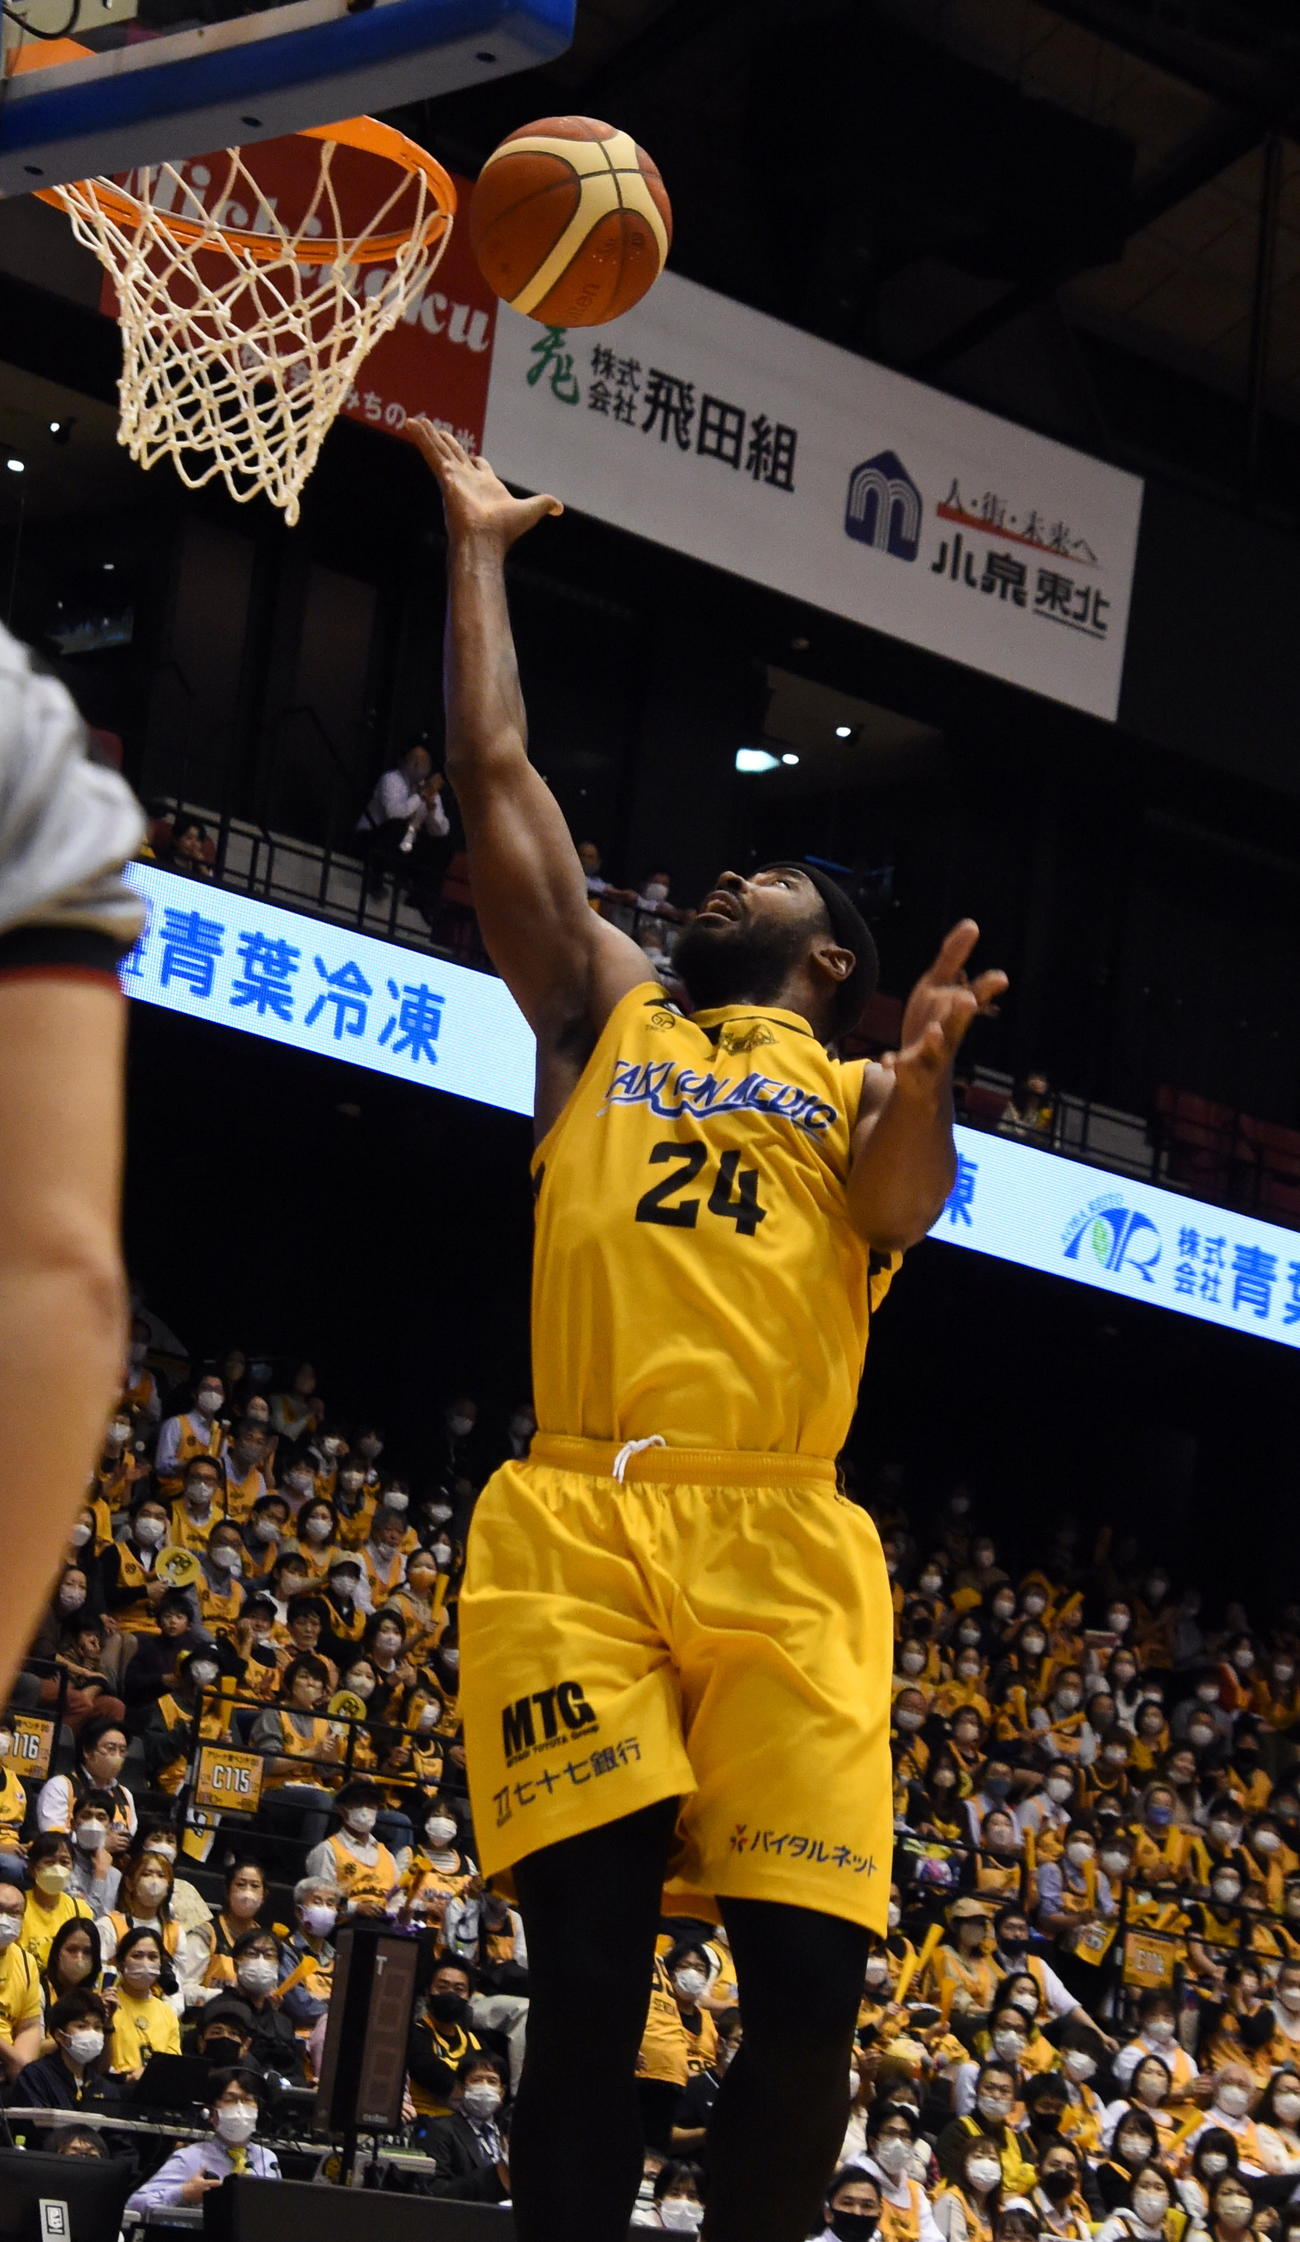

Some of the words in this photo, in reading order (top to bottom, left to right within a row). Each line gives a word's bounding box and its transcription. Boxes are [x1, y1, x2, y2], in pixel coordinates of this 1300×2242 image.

[591, 342, 642, 392] 株式
[588, 381, 637, 427] 会社
[642, 367, 797, 493] 飛田組
[635, 1140, 767, 1237] 24
[1177, 1223, 1228, 1271] 株式
[1174, 1261, 1223, 1304] 会社
[502, 1681, 597, 1758] MTG
[211, 1763, 251, 1794] C115
[513, 1736, 641, 1806] 七十七銀行
[750, 1830, 878, 1877] バイタルネット
